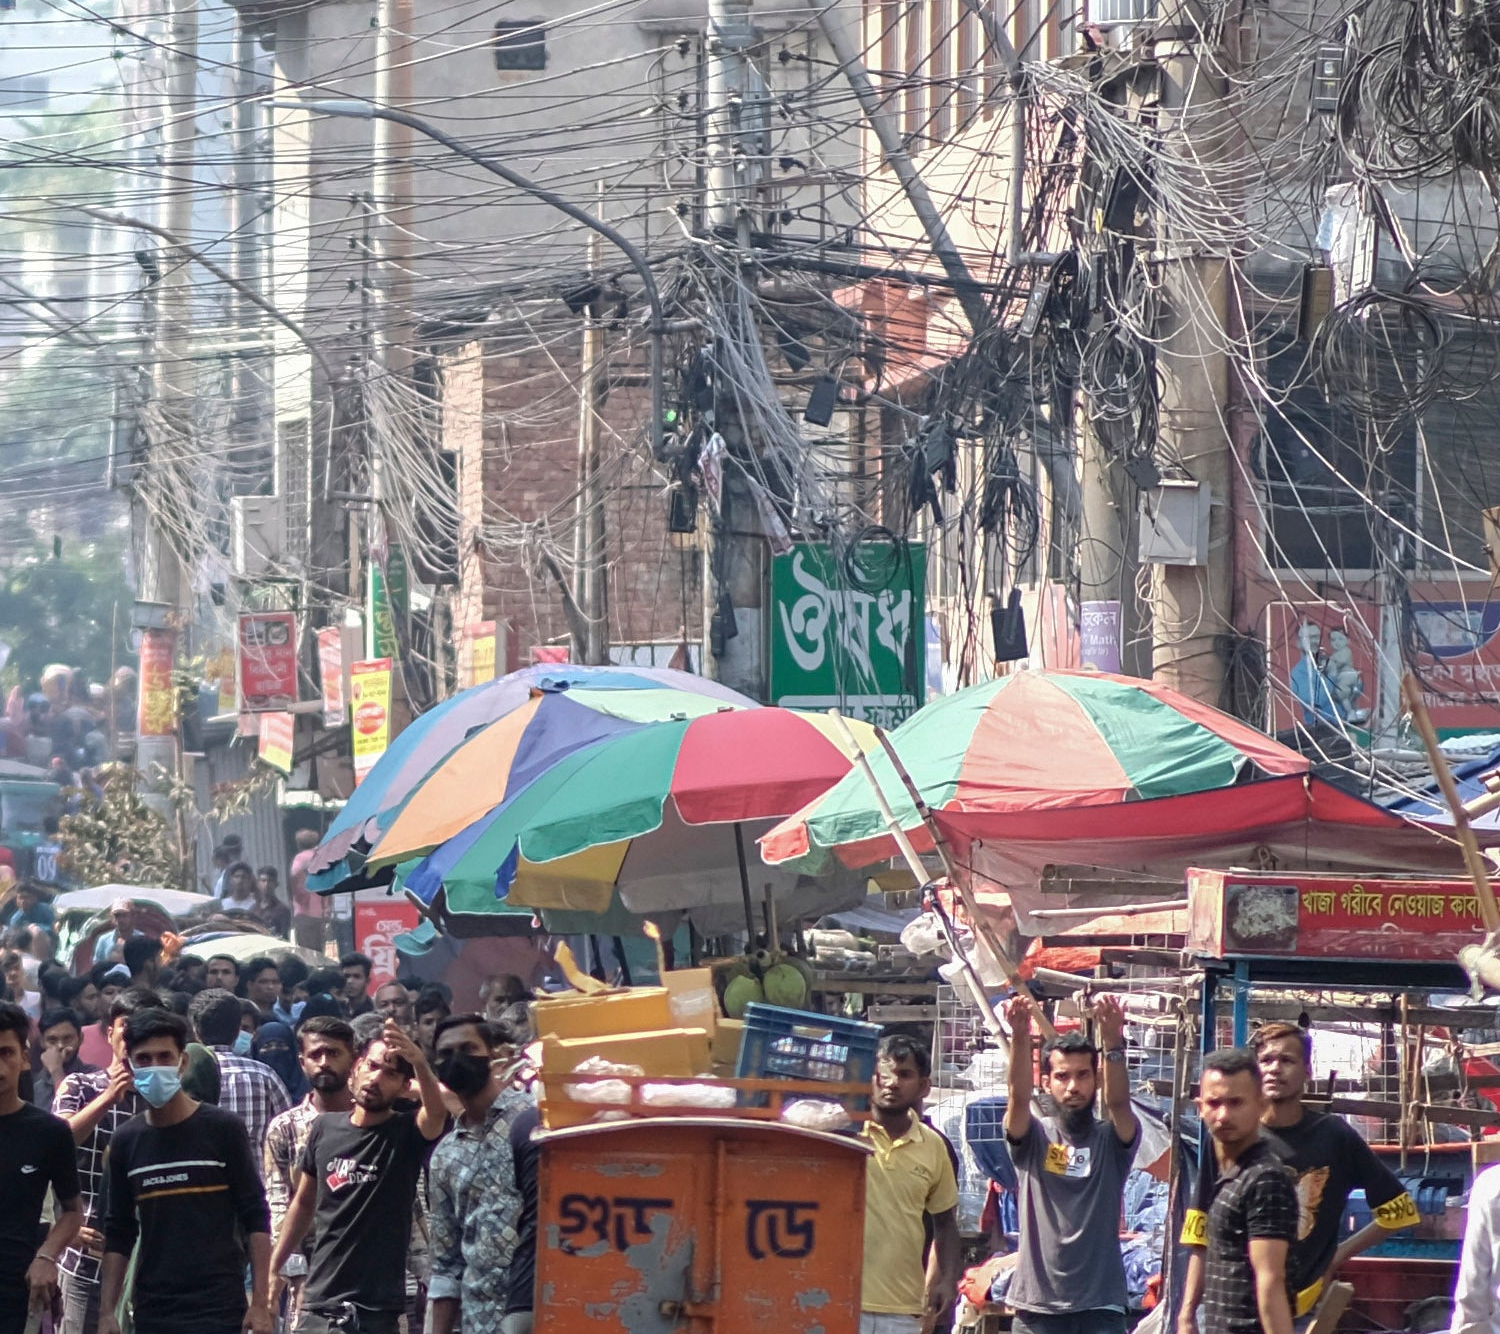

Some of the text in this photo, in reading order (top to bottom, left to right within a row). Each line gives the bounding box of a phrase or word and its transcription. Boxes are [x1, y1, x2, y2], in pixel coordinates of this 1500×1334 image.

[779, 549, 912, 672] ঔষধ
[1302, 889, 1335, 916] খাজা
[1340, 889, 1382, 915] গরীবে
[1388, 893, 1445, 919] নেওয়াজ
[1449, 896, 1484, 920] কাবা
[745, 1198, 818, 1259] ডে
